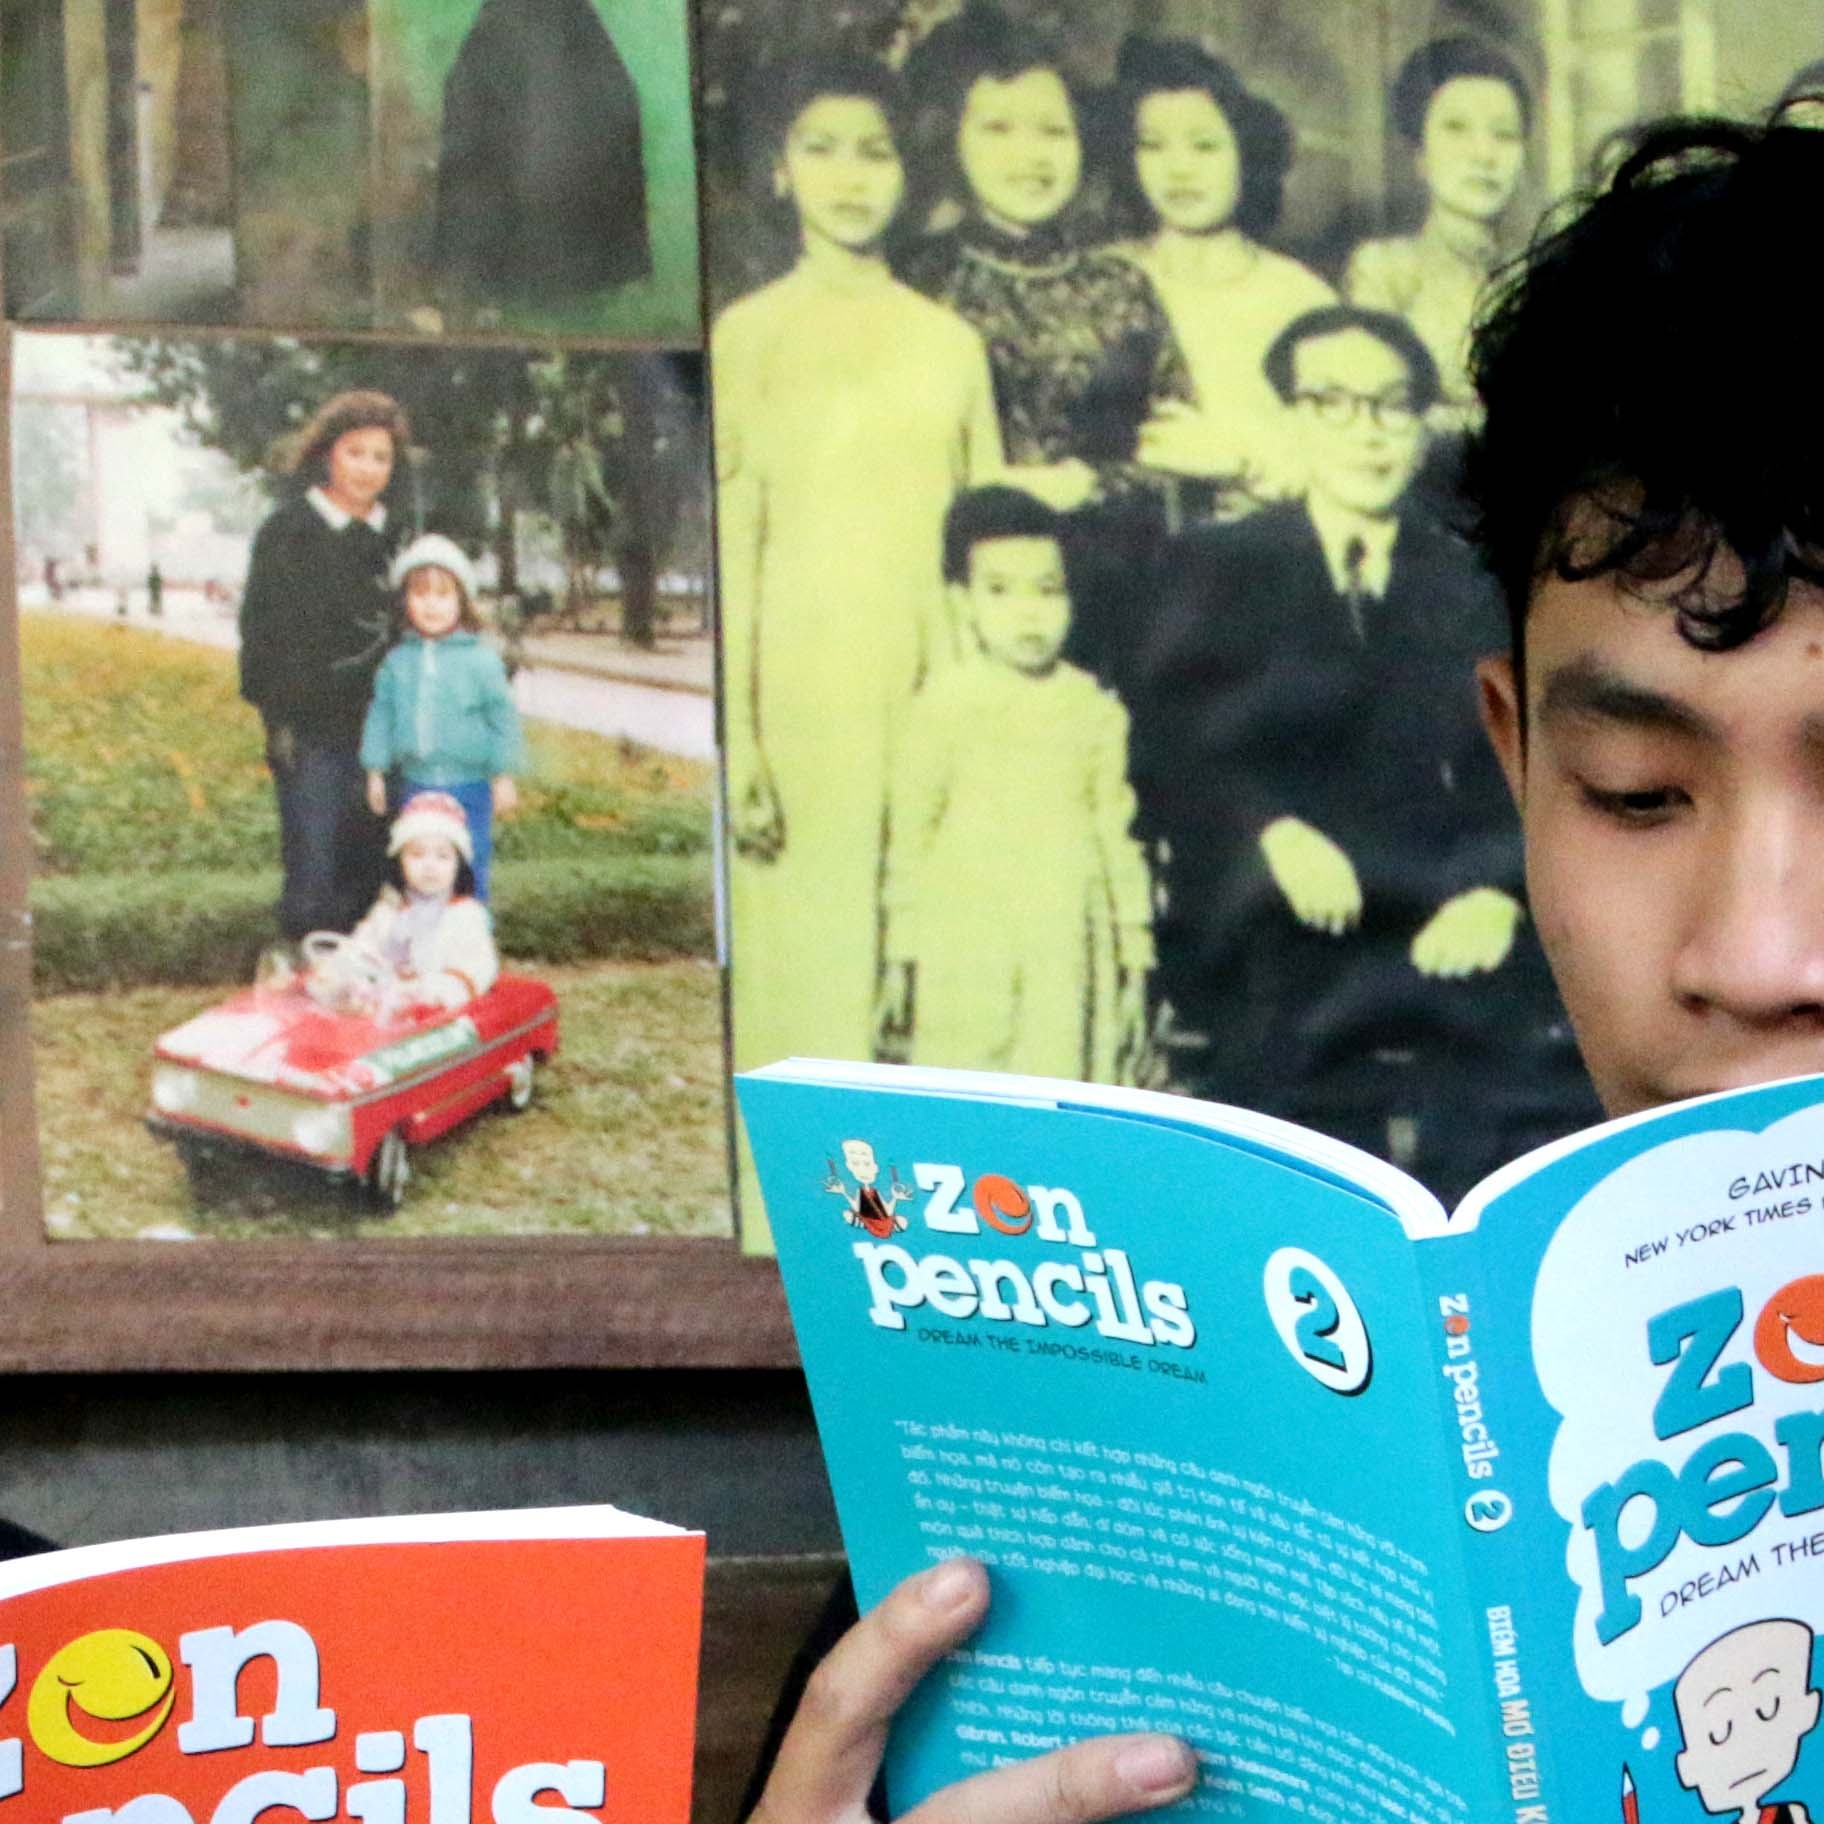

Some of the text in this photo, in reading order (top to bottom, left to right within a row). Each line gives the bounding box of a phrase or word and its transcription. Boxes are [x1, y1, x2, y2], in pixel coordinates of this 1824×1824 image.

[1624, 1234, 1669, 1269] NEW
[1676, 1215, 1736, 1247] YORK
[1743, 1196, 1814, 1226] TIMES
[854, 1241, 1197, 1348] pencils
[1287, 1266, 1347, 1373] 2
[918, 1327, 1208, 1385] DREAM THE IMPOSSIBLE DREAM
[1442, 1361, 1499, 1480] pencils
[1471, 1500, 1505, 1523] 2
[1659, 1555, 1761, 1618] DREAM
